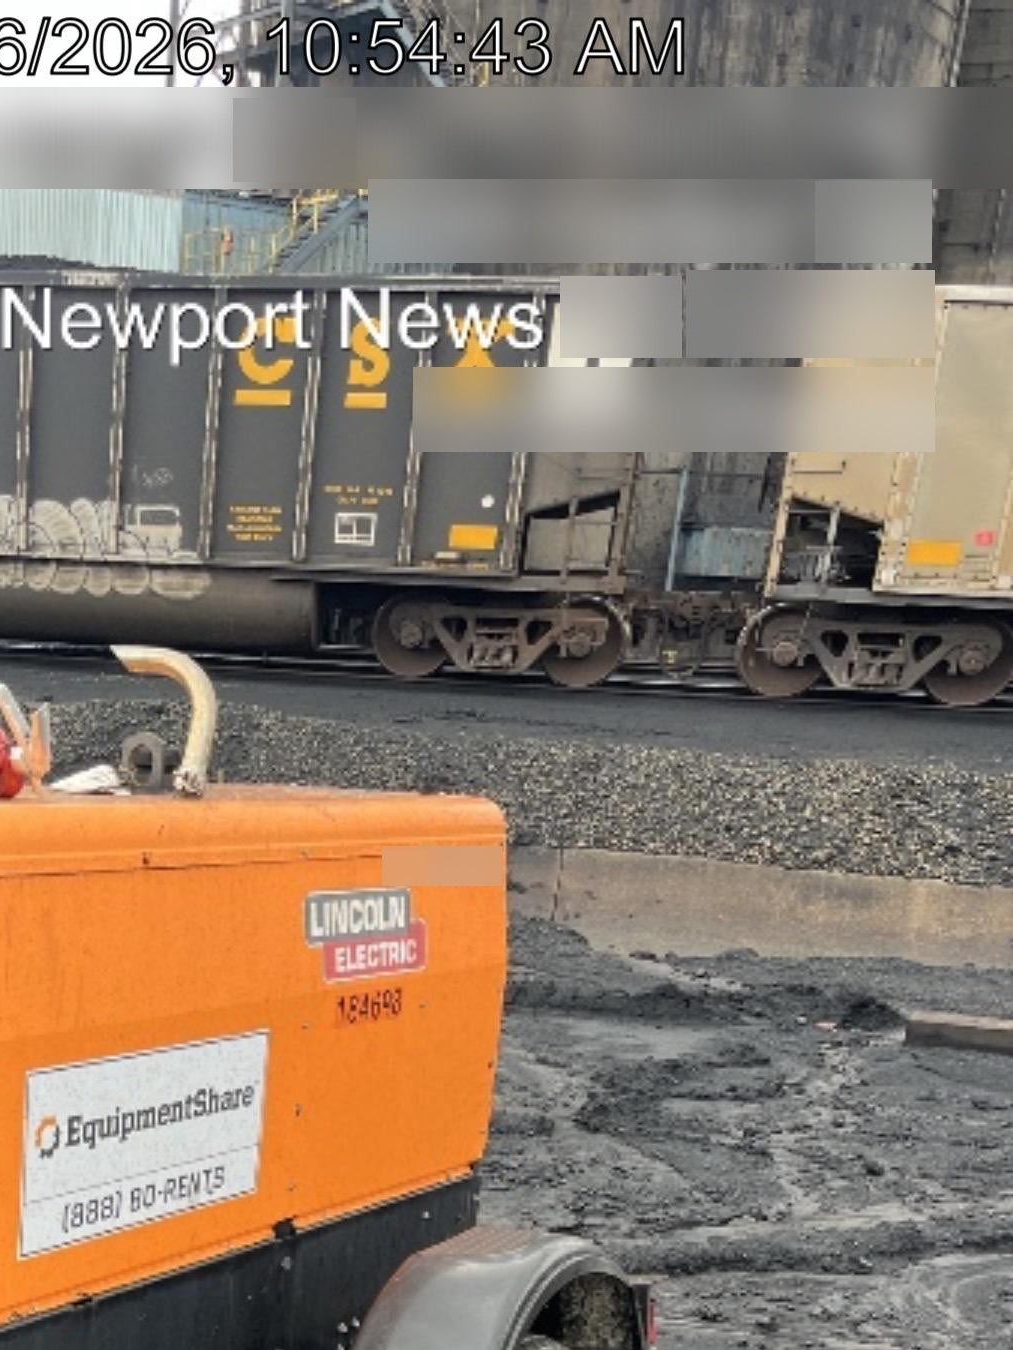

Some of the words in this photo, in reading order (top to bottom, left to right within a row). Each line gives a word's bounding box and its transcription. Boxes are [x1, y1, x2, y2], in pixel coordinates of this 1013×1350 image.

[310, 896, 406, 937] LINCOLN
[334, 938, 417, 973] ELECTRIC
[64, 1085, 256, 1149] EquipmentShare
[61, 1191, 123, 1234] (888)
